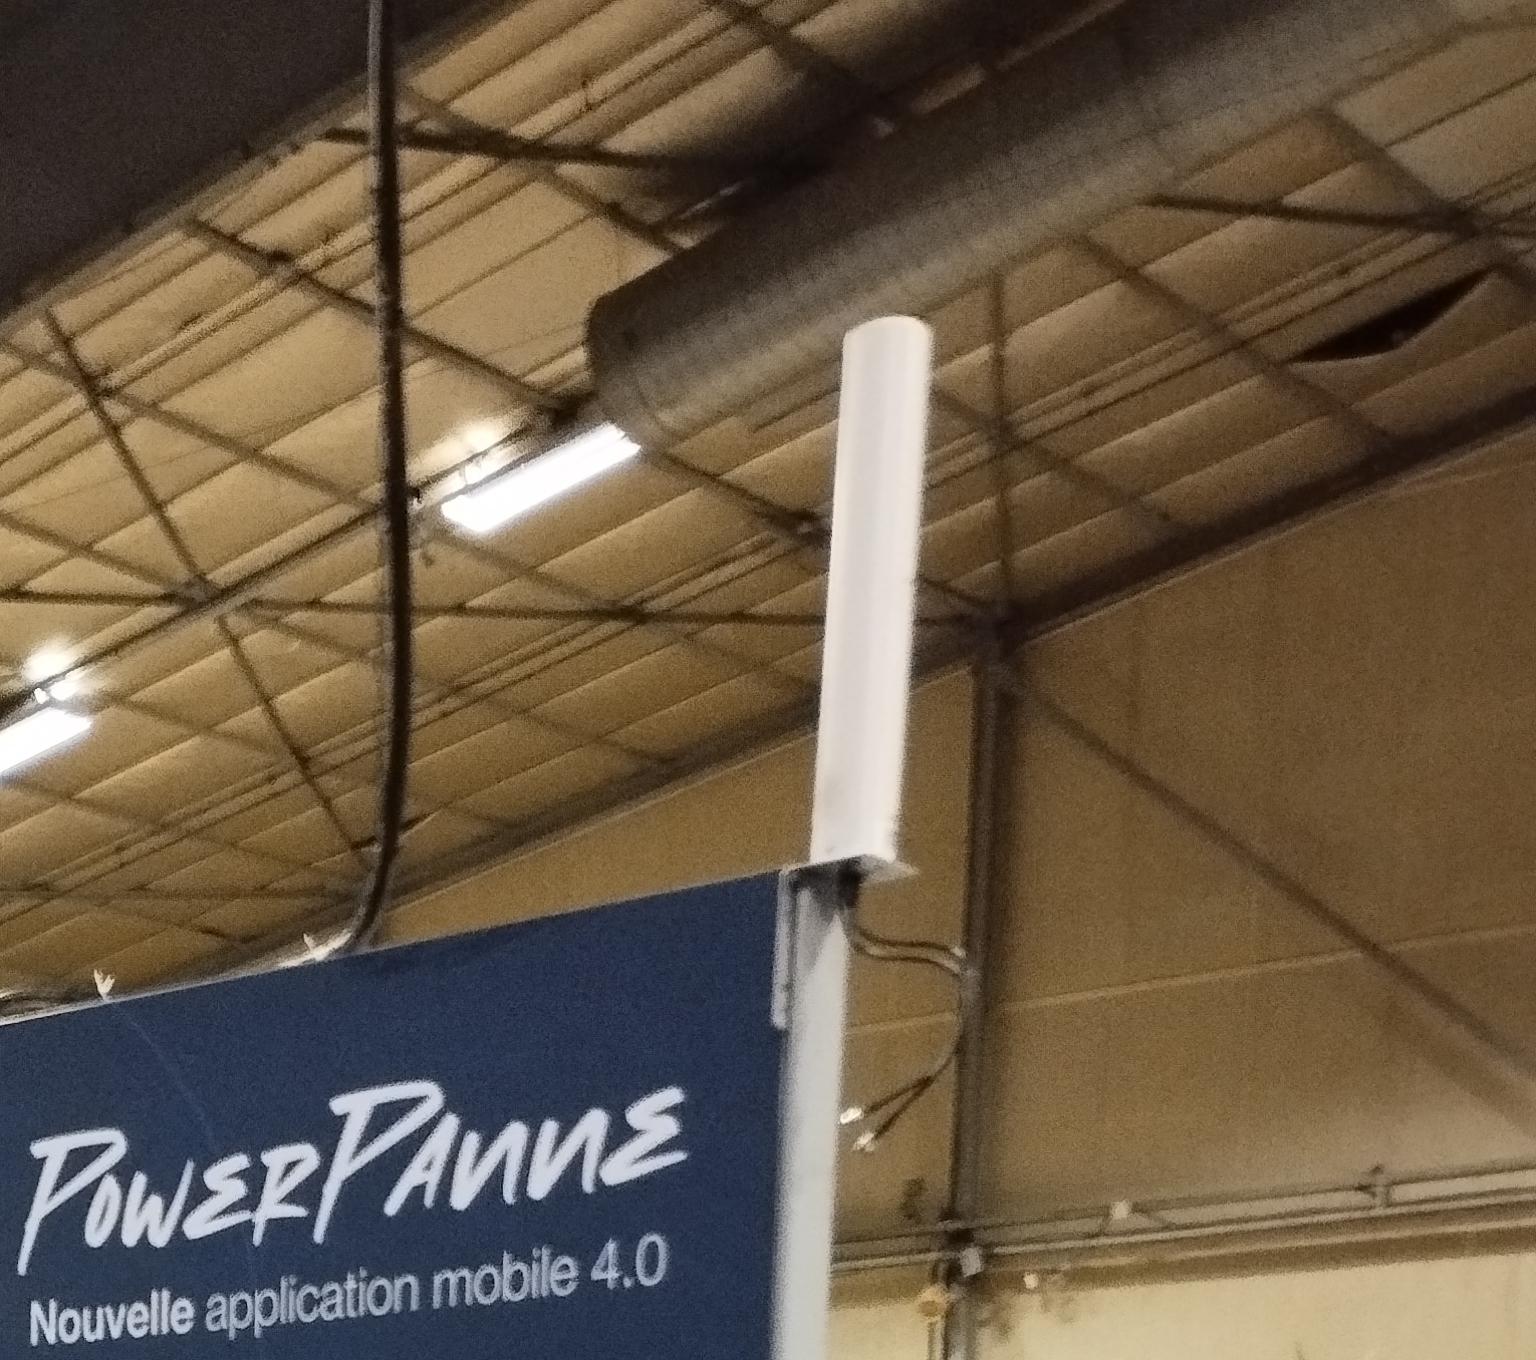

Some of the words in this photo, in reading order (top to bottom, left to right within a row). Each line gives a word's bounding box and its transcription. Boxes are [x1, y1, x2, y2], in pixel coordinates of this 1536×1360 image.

[29, 1287, 196, 1347] Nouvelle
[204, 1264, 420, 1341] application
[432, 1245, 580, 1310] mobile
[590, 1232, 668, 1290] 4.0
